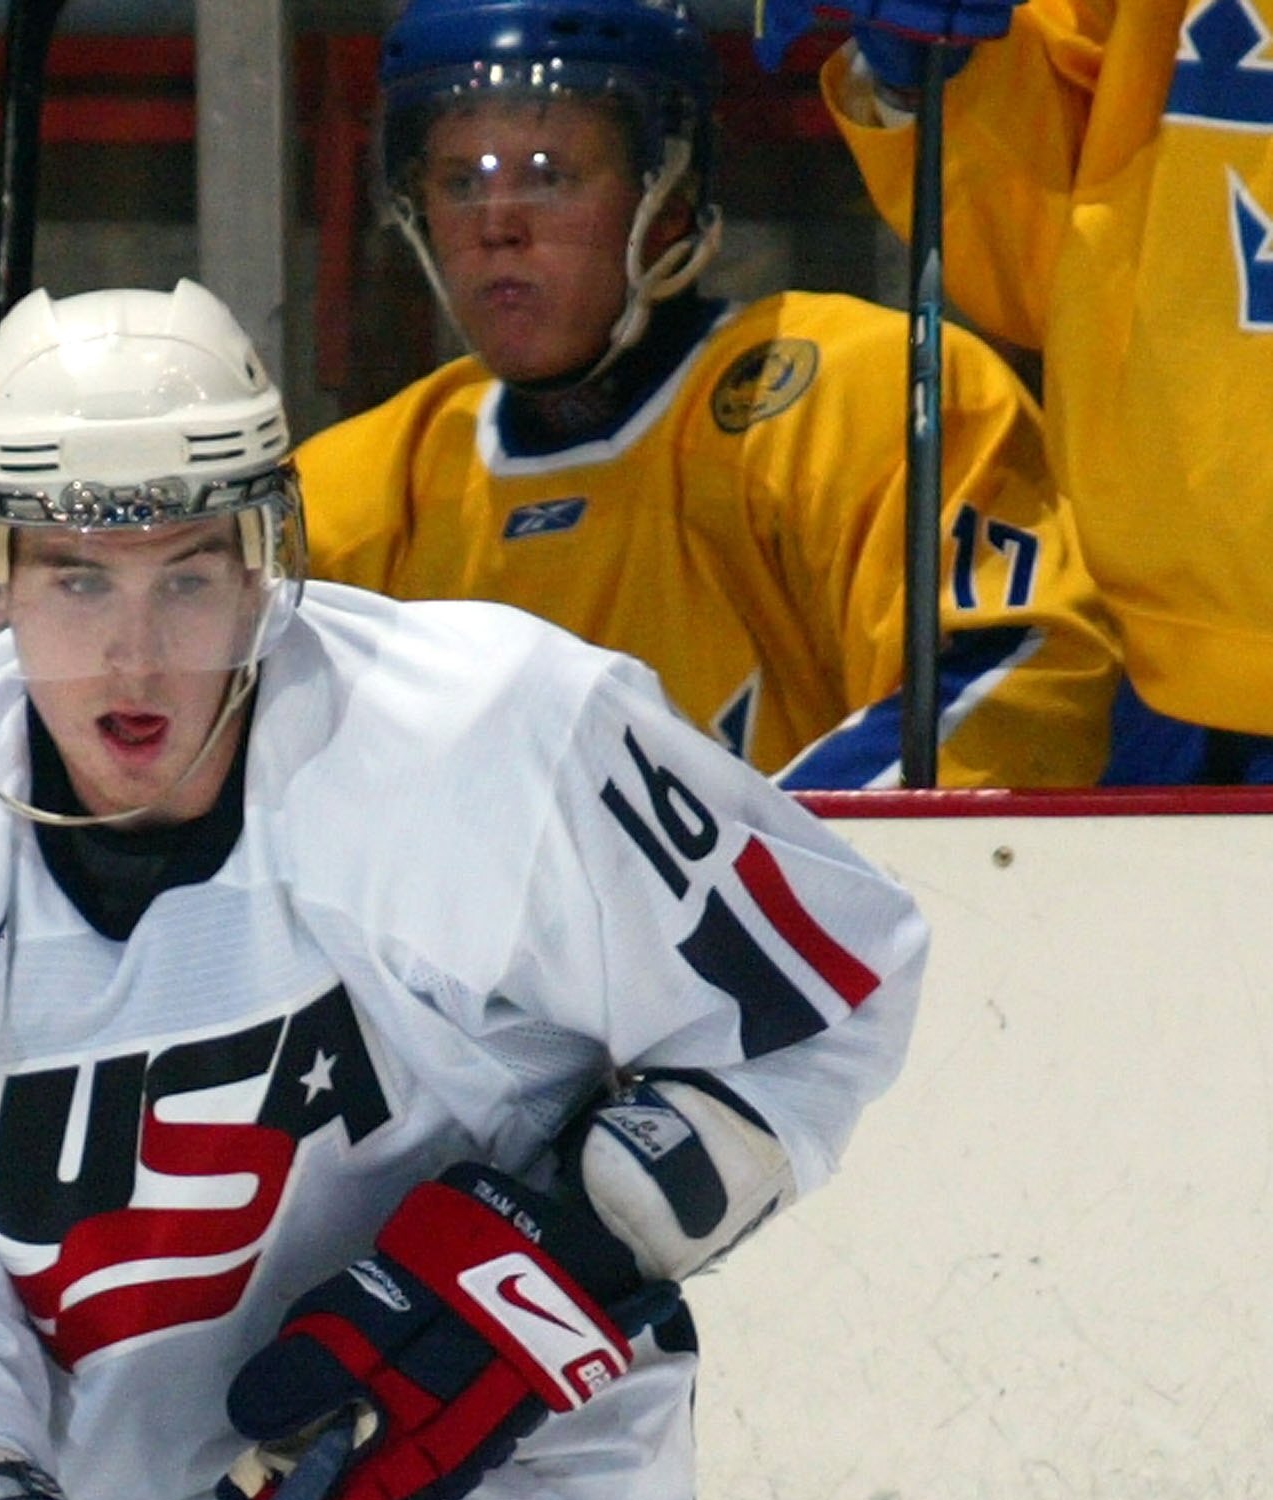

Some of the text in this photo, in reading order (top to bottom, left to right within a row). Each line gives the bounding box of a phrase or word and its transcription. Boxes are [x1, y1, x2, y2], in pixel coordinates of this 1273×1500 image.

[950, 502, 1039, 610] 17
[599, 723, 720, 902] 16
[472, 1179, 544, 1245] TEAM USA
